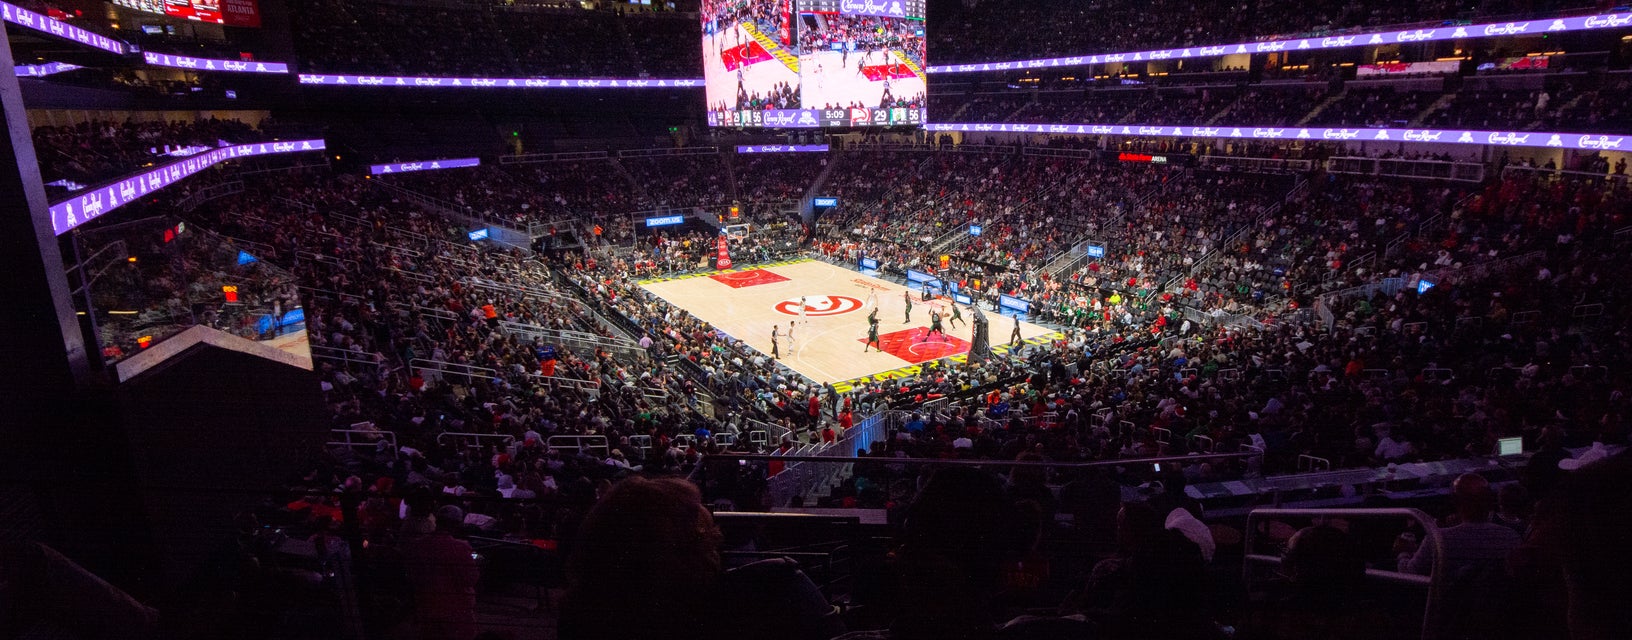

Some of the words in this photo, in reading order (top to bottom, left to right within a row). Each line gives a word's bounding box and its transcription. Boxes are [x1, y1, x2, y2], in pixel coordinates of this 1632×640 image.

[228, 5, 255, 14] ATLANTA
[841, 0, 864, 13] Crown
[860, 0, 888, 14] Royal
[1584, 16, 1606, 28] Crown
[1602, 14, 1632, 27] Royal
[733, 111, 740, 120] 29
[753, 111, 761, 120] 56
[763, 112, 779, 124] Crown
[776, 111, 796, 124] Royal
[826, 110, 844, 119] 5:09
[874, 110, 887, 121] 29
[909, 109, 919, 120] 56
[1253, 128, 1268, 137] Crown
[1265, 128, 1284, 138] Royal
[1323, 129, 1340, 139] Crown
[1337, 129, 1359, 139] Royal
[1403, 130, 1421, 140] Crown
[1418, 130, 1442, 141] Royal
[1488, 132, 1507, 144] Crown
[1504, 132, 1530, 145] Royal
[1579, 135, 1600, 148] Crown
[1596, 135, 1624, 149] Royal
[650, 217, 680, 225] zoom.us
